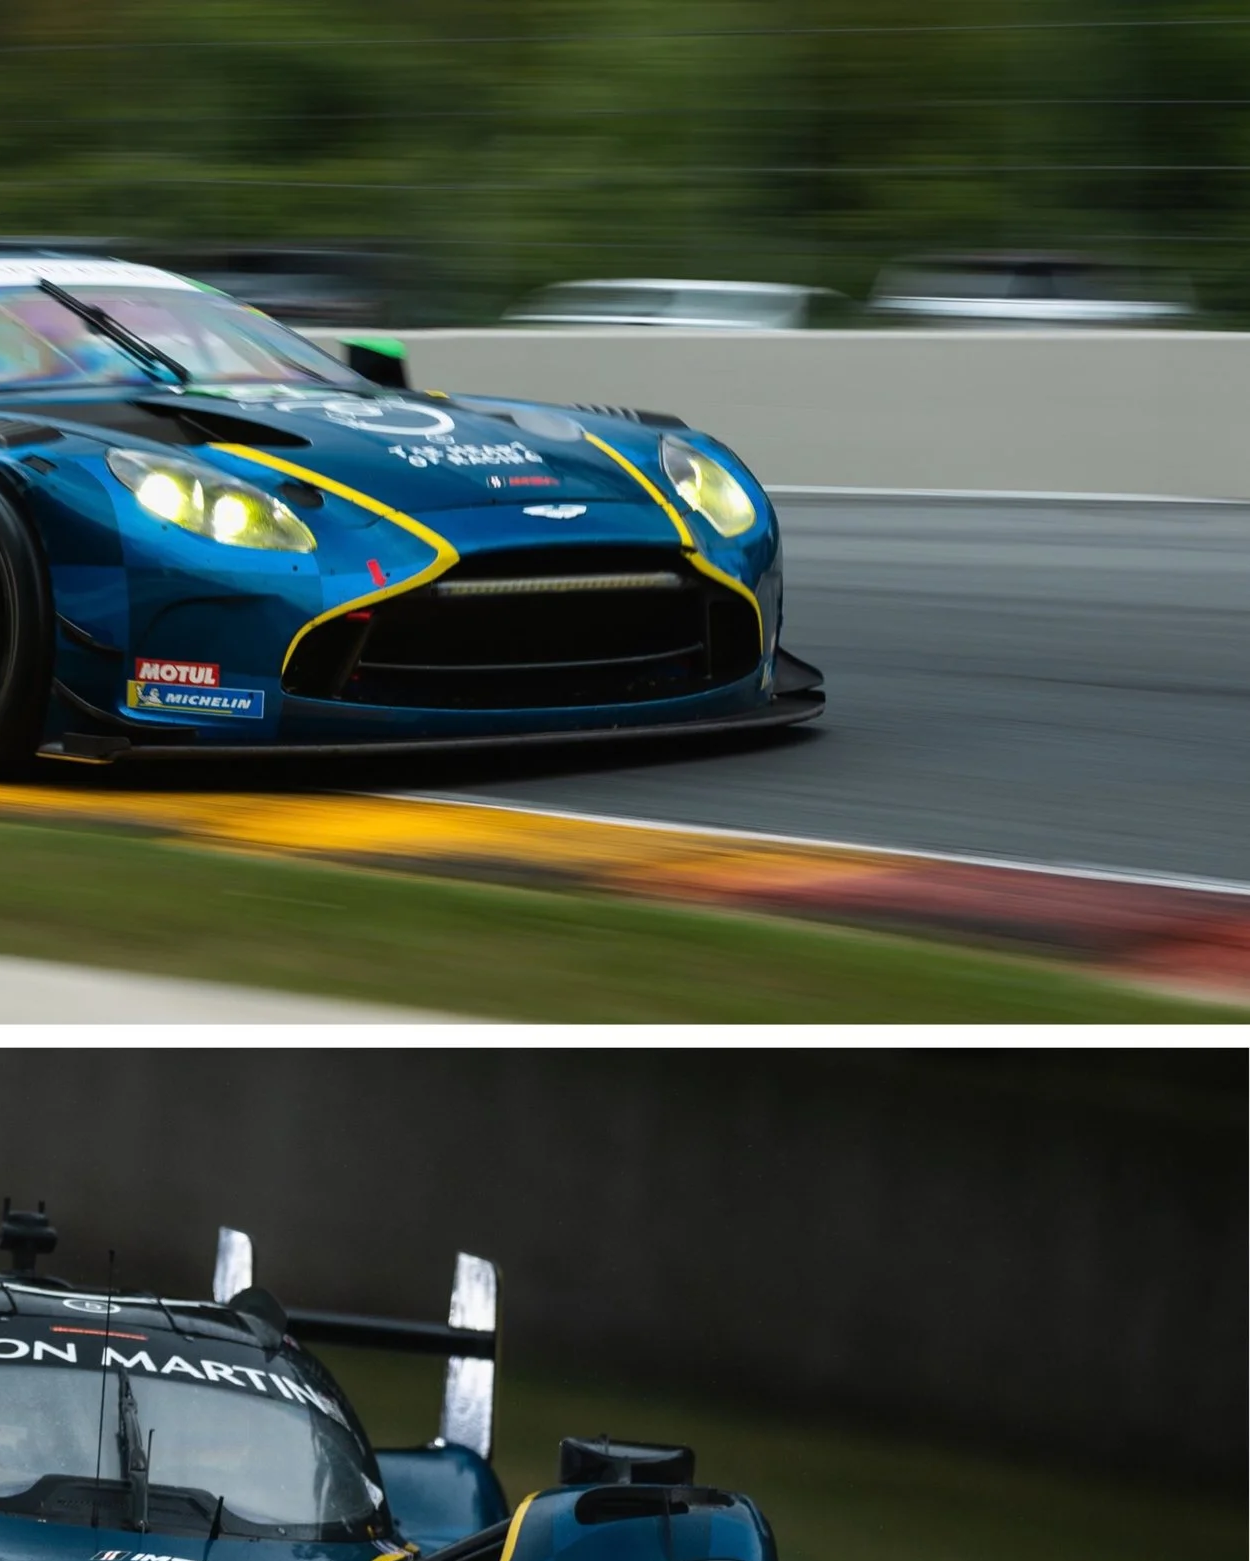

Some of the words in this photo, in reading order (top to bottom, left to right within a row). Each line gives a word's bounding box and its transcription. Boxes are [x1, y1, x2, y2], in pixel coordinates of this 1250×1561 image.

[139, 662, 215, 684] MOTUL
[165, 693, 251, 709] MICHELIN
[101, 1347, 328, 1415] MARTIN
